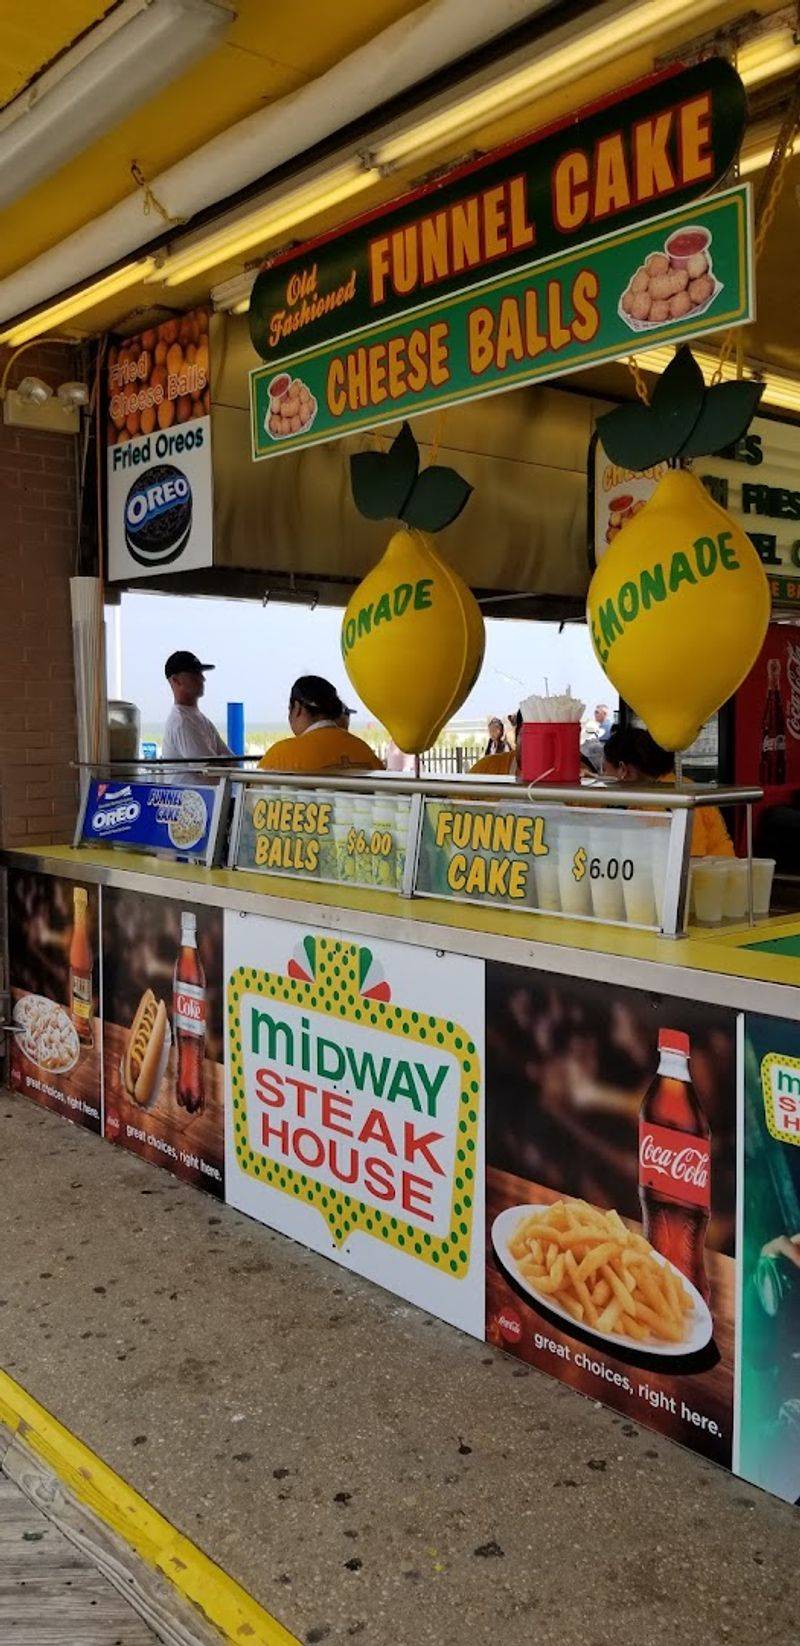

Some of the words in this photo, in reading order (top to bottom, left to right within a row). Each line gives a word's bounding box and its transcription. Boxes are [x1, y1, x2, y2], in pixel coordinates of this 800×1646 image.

[368, 175, 537, 304] FUNNEL
[554, 93, 715, 232] CAKE
[268, 271, 357, 347] Fashioned
[286, 264, 318, 305] Old
[108, 351, 149, 390] Fried
[326, 322, 451, 419] CHEESE
[467, 268, 600, 377] BALLS
[109, 383, 164, 420] Cheese
[167, 366, 207, 401] Balls
[113, 442, 150, 472] Fried
[155, 427, 205, 460] Oreos
[127, 478, 189, 524] OREO
[342, 579, 435, 655] ONADE
[92, 803, 141, 830] OREO
[252, 799, 333, 836] CHEESE
[347, 826, 393, 857] $6.00
[435, 810, 550, 856] FUNNEL
[254, 834, 321, 872] BALLS
[447, 854, 529, 899] CAKE
[572, 848, 634, 882] $6.00
[176, 994, 202, 1020] Coke
[255, 1068, 447, 1177] STEAK
[126, 1124, 146, 1142] great
[147, 1135, 178, 1161] choices,
[180, 1150, 199, 1170] right
[200, 1159, 223, 1181] here.
[261, 1111, 435, 1222] HOUSE
[639, 1135, 711, 1189] Coca-Cola
[533, 1332, 572, 1361] great
[574, 1352, 635, 1396] choices,
[638, 1384, 677, 1415] right
[680, 1401, 723, 1438] here.
